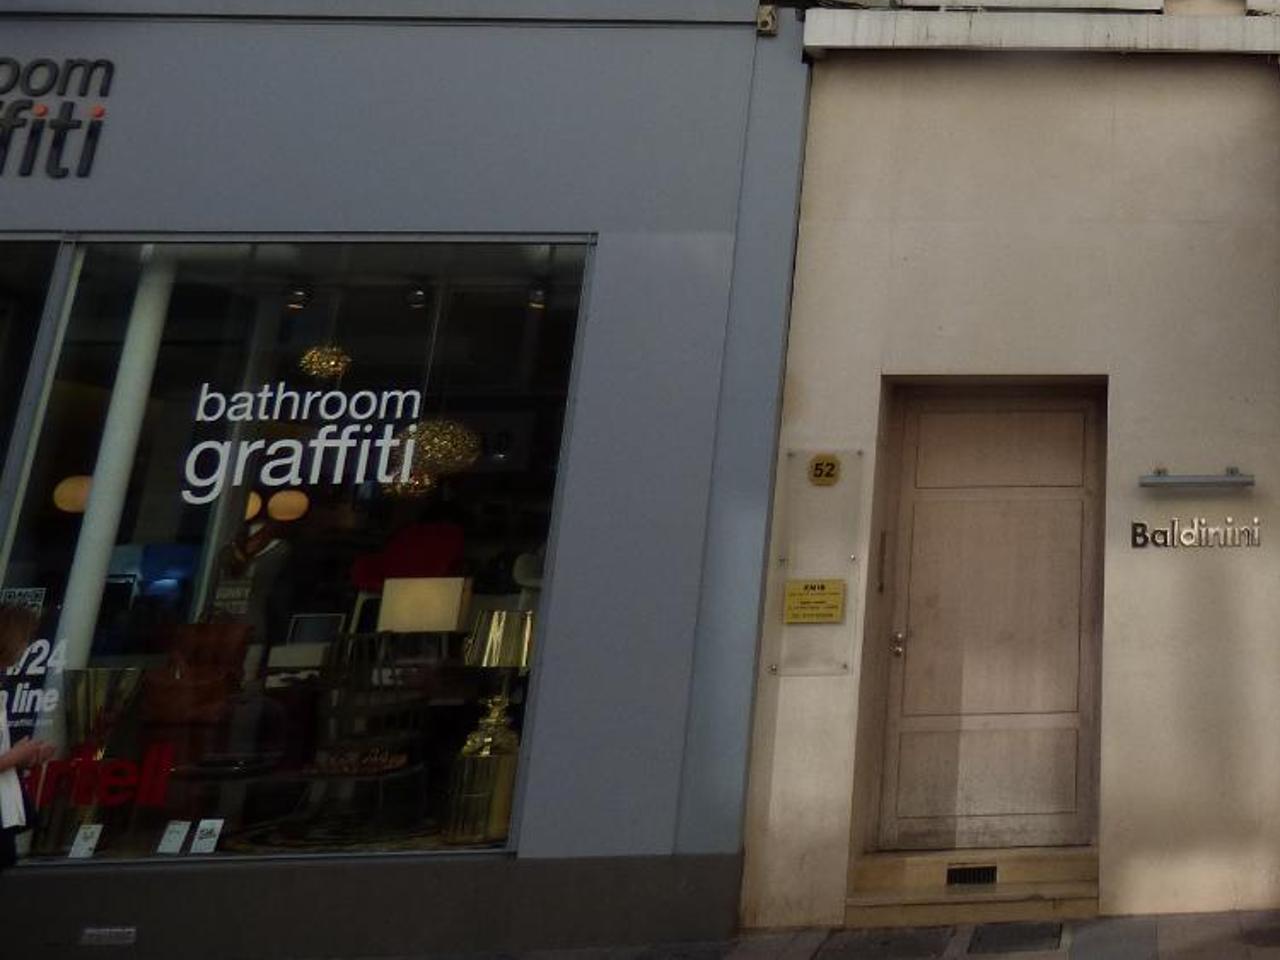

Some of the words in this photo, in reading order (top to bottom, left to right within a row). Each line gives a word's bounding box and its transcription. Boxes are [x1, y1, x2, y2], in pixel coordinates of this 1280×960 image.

[194, 382, 422, 422] bathroom
[181, 423, 418, 506] graffiti
[813, 461, 836, 478] 52
[1131, 516, 1262, 549] Baldinini
